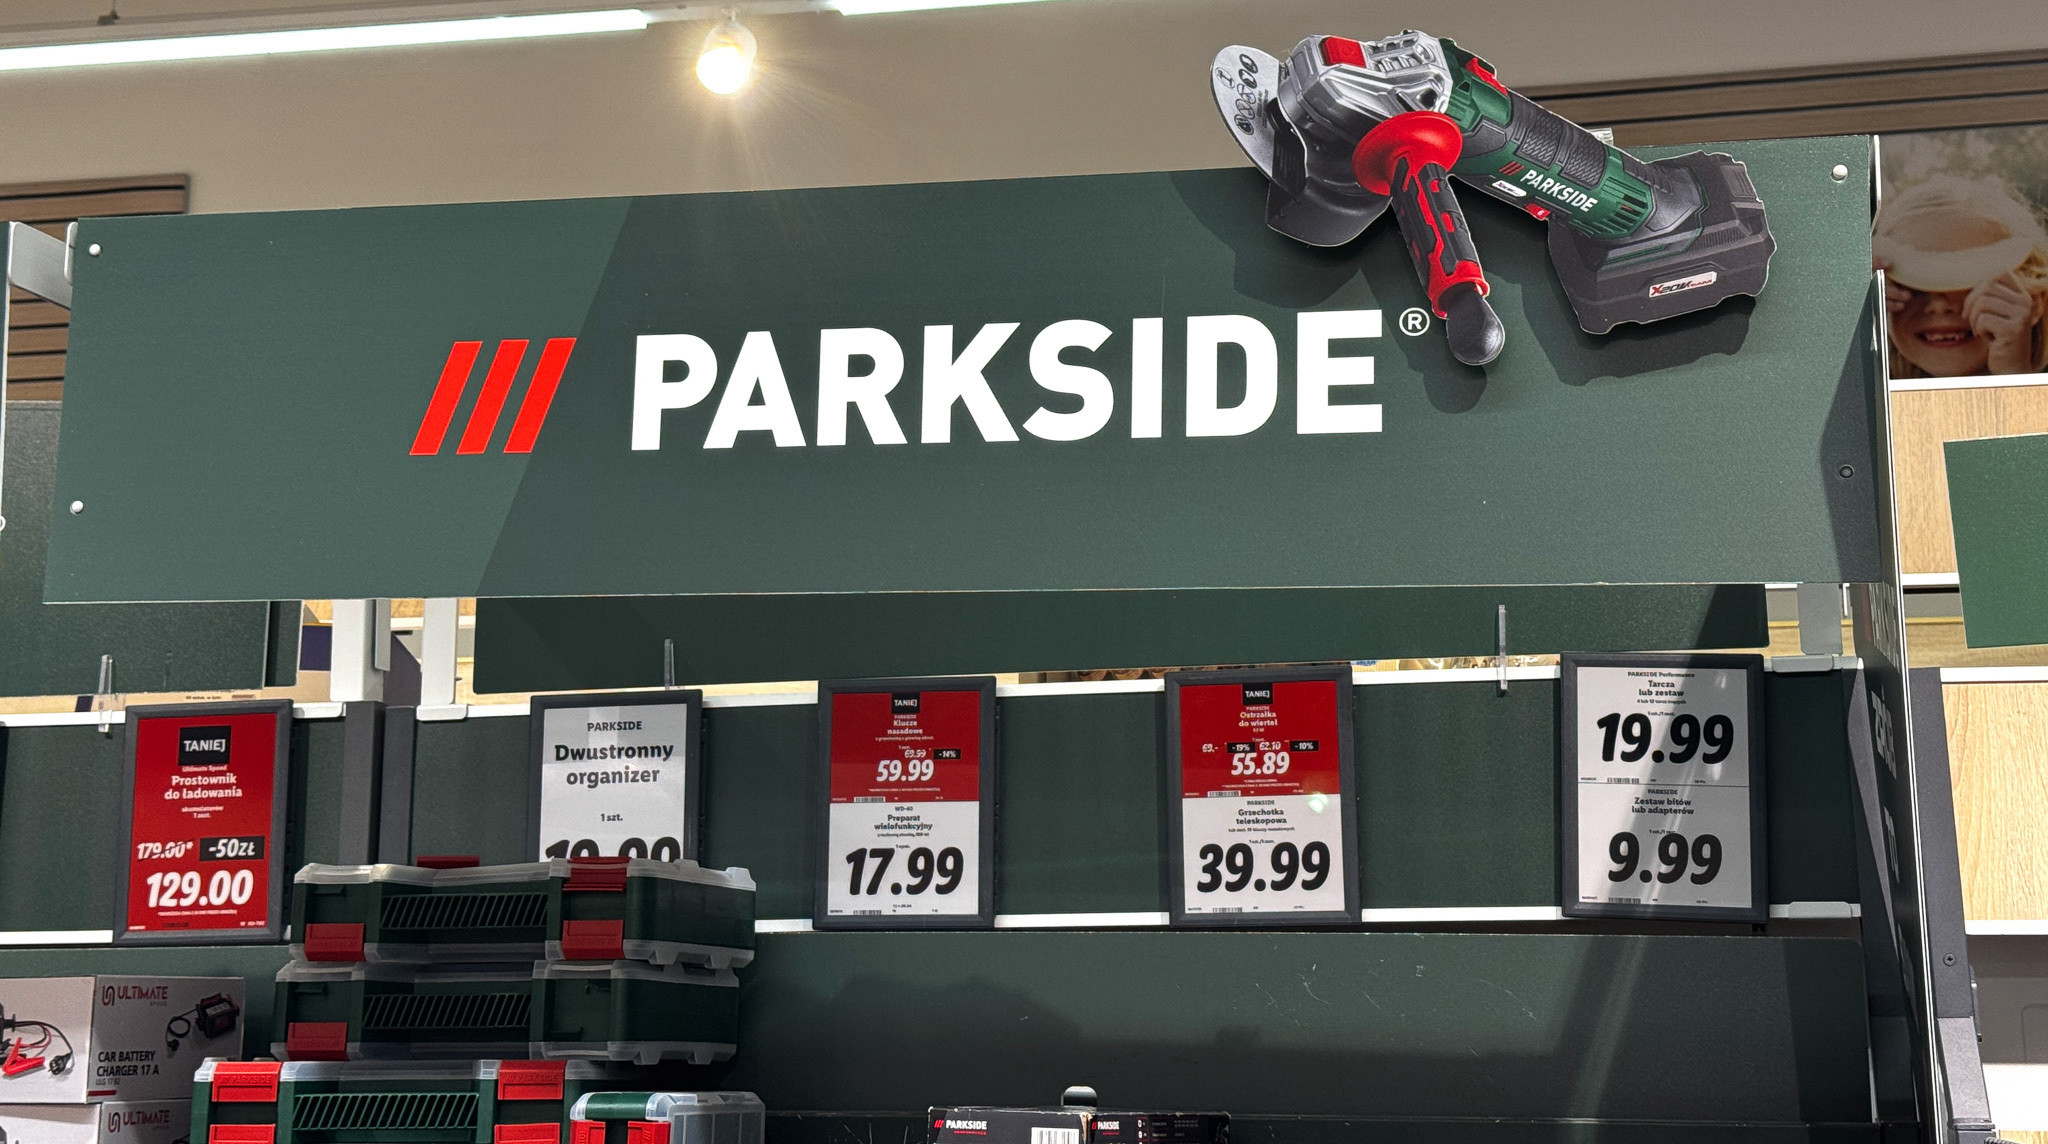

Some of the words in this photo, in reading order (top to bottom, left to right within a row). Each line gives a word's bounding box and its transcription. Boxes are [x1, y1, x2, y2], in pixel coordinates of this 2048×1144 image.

[1519, 169, 1599, 212] PARKSIDE
[631, 309, 1384, 451] PARKSIDE
[1245, 690, 1270, 698] TANIEJ
[894, 699, 917, 707] TANIEJ
[587, 720, 642, 732] PARKSIDE
[1596, 712, 1734, 764] 19.99
[183, 739, 226, 752] TANIEJ
[1232, 744, 1250, 752] -19%
[1259, 742, 1281, 751] 62.10
[1294, 742, 1314, 750] -10%
[554, 744, 674, 762] Dwustronny
[939, 750, 956, 758] -14%
[1231, 751, 1290, 776] 55.89
[566, 765, 660, 789] organizer
[876, 760, 934, 782] 59.99
[172, 772, 237, 786] Prostownik
[164, 788, 180, 800] do
[1634, 797, 1665, 806] Zestaw
[1667, 798, 1692, 806] bitów
[600, 813, 605, 822] 1
[607, 813, 623, 822] szt.
[1238, 808, 1284, 816] Grzechotka
[1648, 807, 1694, 816] adapterów
[887, 814, 920, 824] Preparat
[1236, 817, 1287, 826] teleskopowa
[874, 822, 933, 831] wielofunkcyjny
[1608, 831, 1722, 885] 9.99
[846, 846, 964, 896] 17.99
[1197, 841, 1331, 892] 39.99
[146, 868, 254, 908] 129.00
[117, 986, 169, 1000] ULTIMATE
[98, 1051, 116, 1062] CAR
[118, 1050, 156, 1062] BATTERY
[96, 1064, 138, 1077] CHARGER
[141, 1064, 151, 1076] 17
[152, 1064, 160, 1075] A
[122, 1110, 170, 1125] ULTIMATE
[946, 1120, 988, 1130] PARKSIDE
